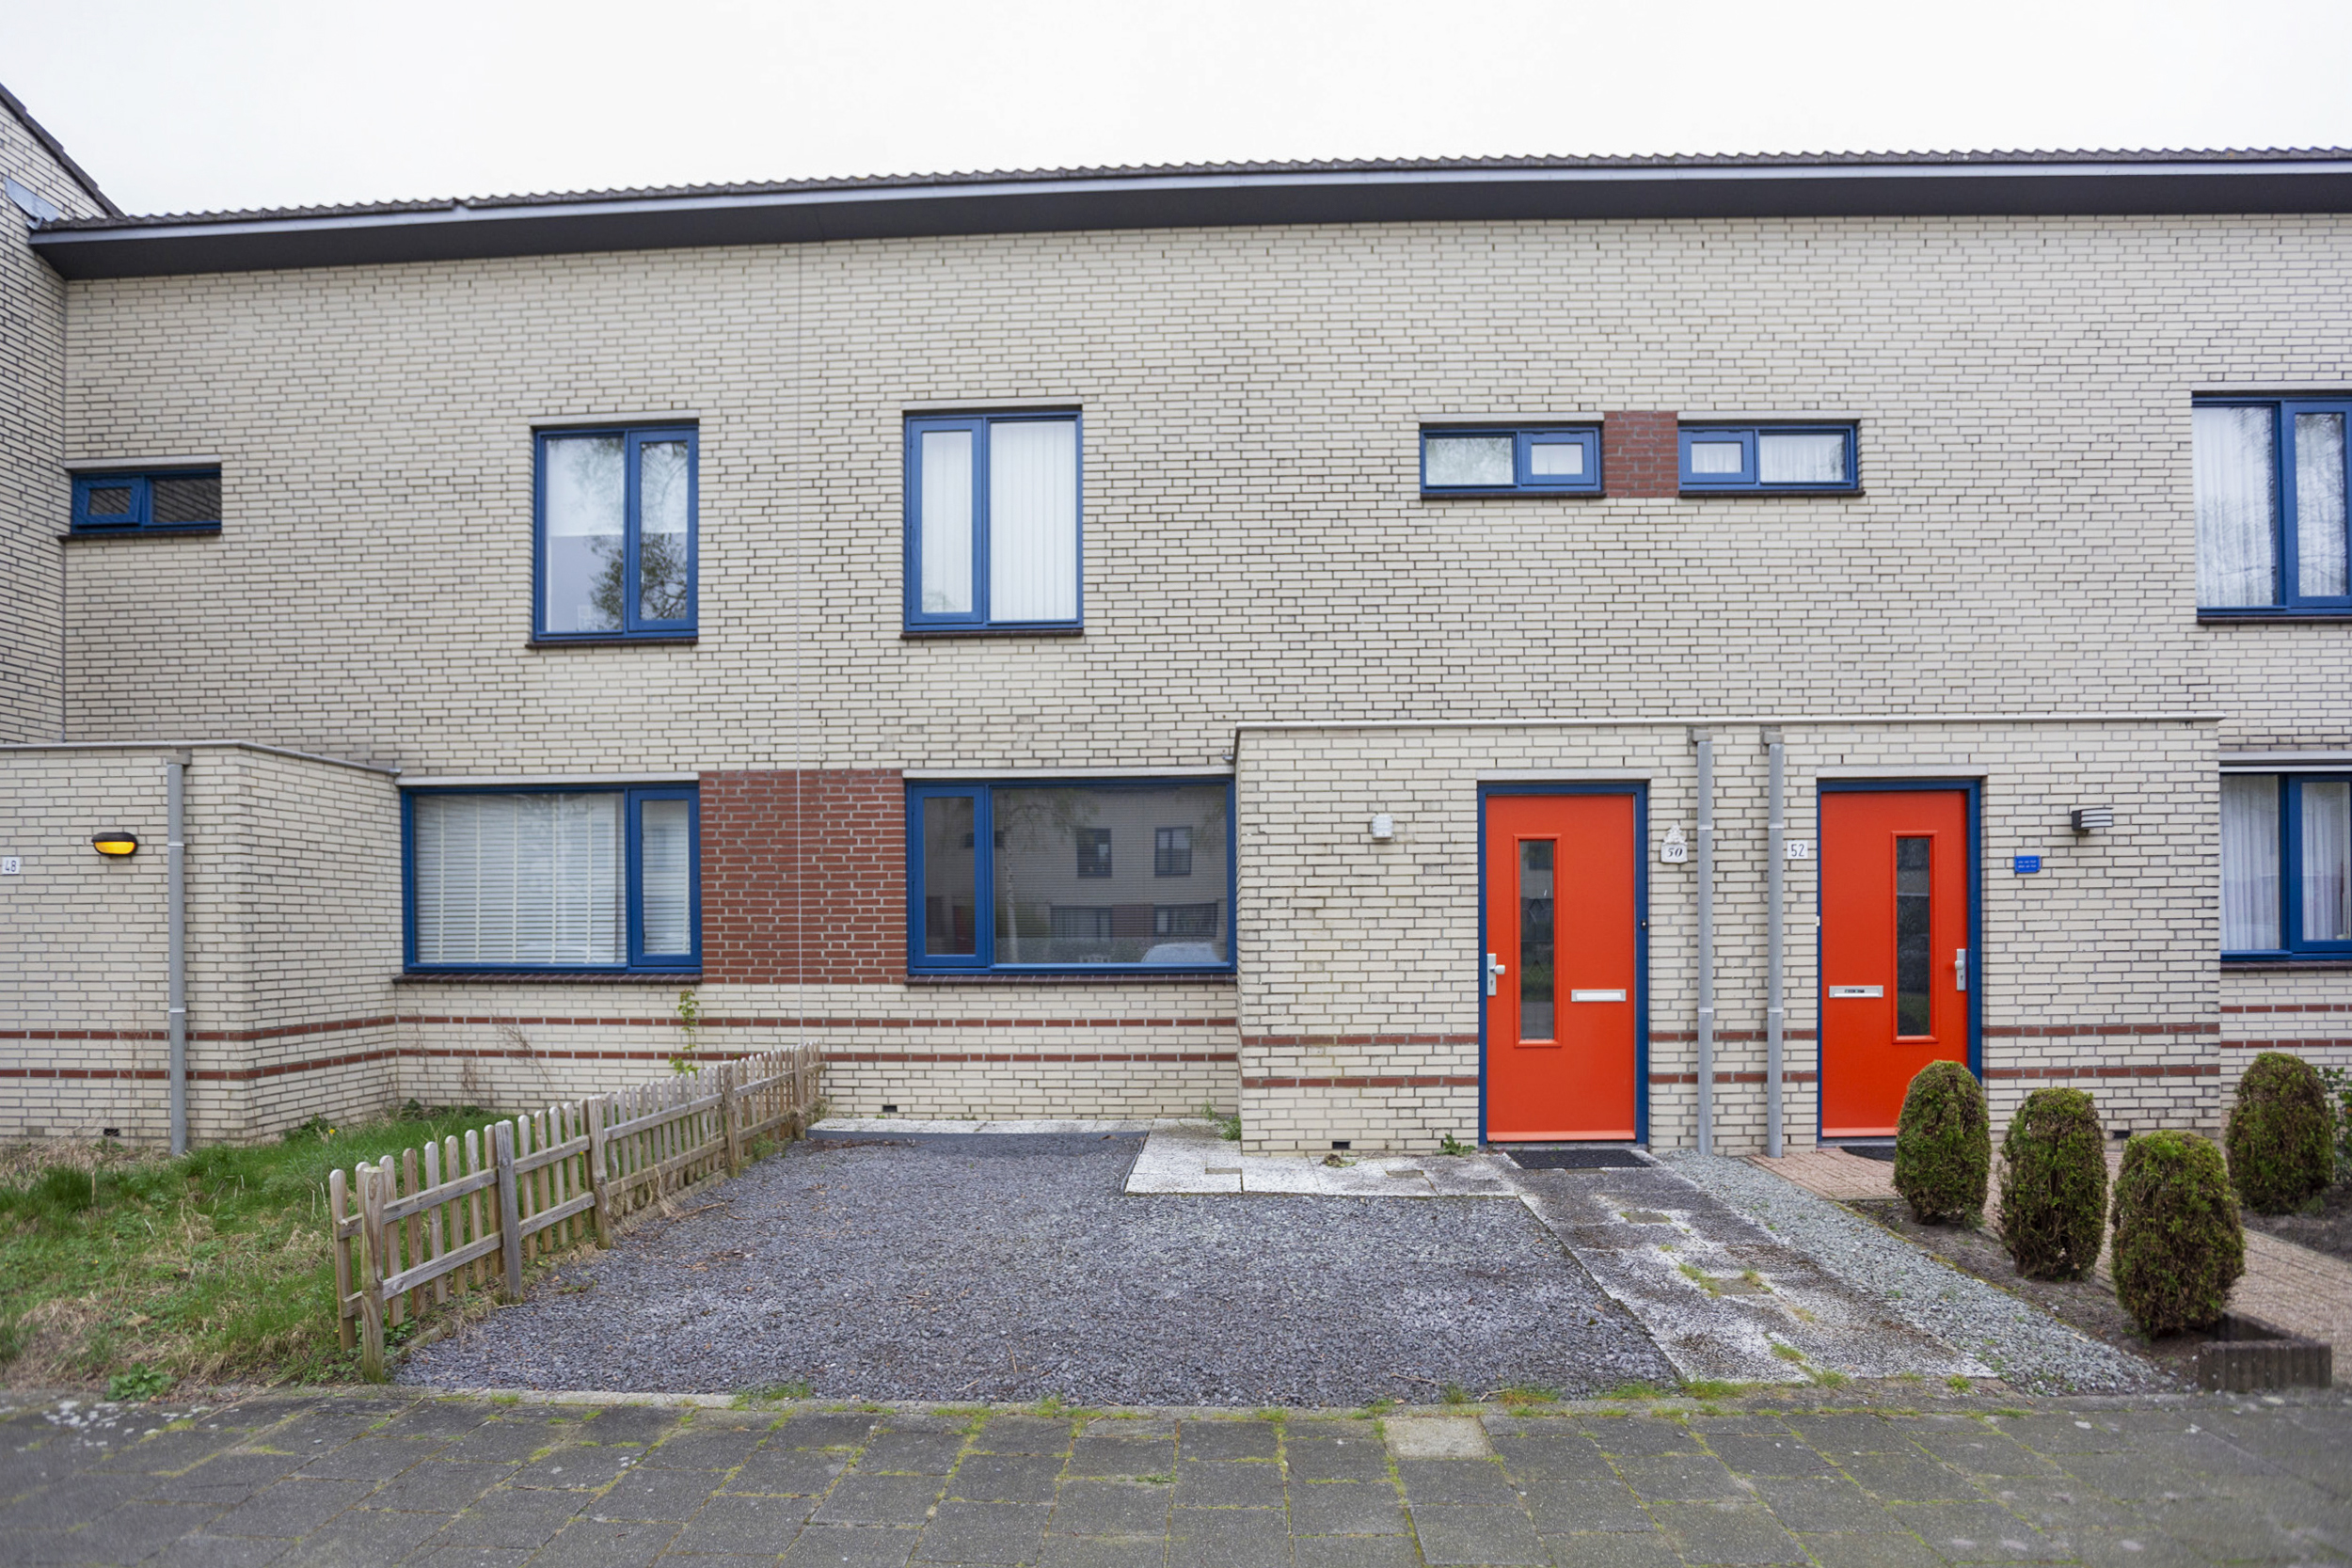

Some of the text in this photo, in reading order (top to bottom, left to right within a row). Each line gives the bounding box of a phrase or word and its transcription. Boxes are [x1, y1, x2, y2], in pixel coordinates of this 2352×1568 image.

[1667, 847, 1683, 857] 50
[1790, 843, 1804, 857] 52
[5, 860, 17, 873] 48
